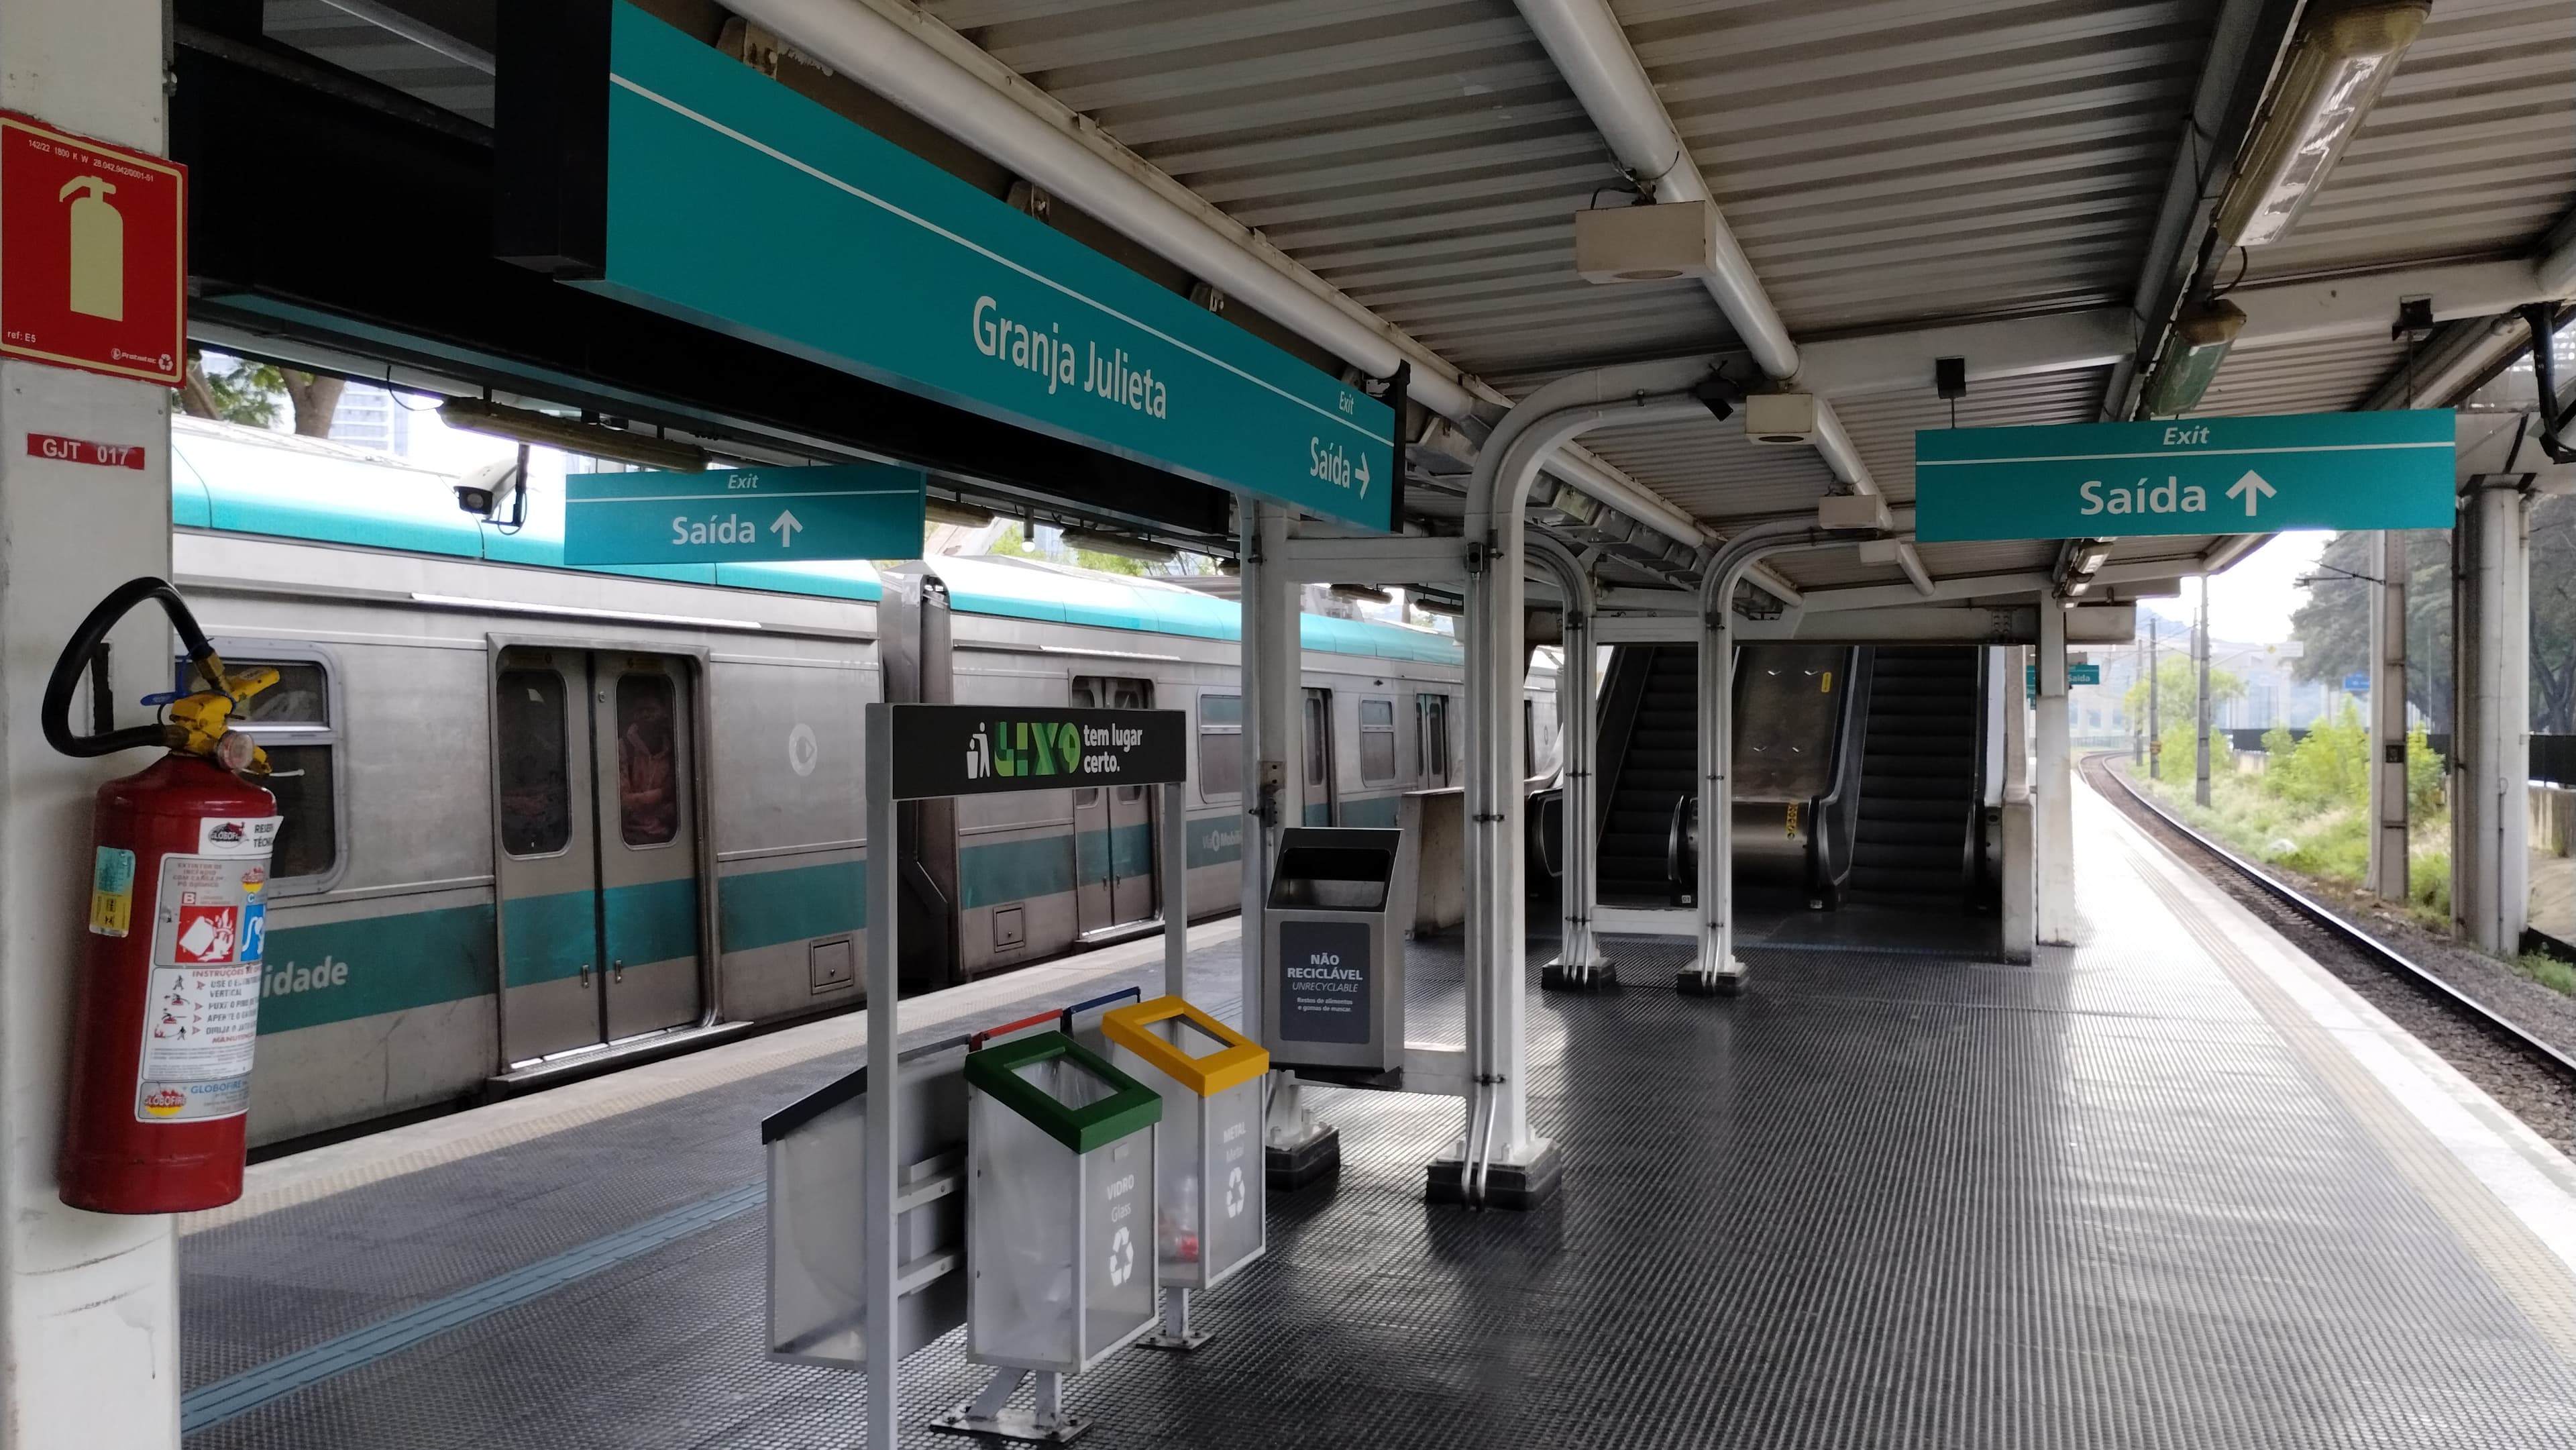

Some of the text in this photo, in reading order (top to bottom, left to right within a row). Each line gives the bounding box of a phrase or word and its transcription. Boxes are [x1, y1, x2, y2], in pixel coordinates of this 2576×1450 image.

[72, 152, 78, 160] K
[80, 155, 89, 164] W
[7, 331, 36, 343] ref: E5
[973, 295, 1167, 420] Granja Julieta
[1339, 391, 1354, 416] Exit
[2162, 426, 2210, 446] Exit
[42, 438, 129, 466] GJT 017
[1309, 435, 1350, 489] Saída
[727, 474, 759, 489] Exit
[2080, 475, 2206, 516] Saída
[672, 513, 755, 546] Saída
[994, 721, 1143, 777] LIXO tem lugar
[1083, 752, 1120, 774] certo.
[184, 892, 195, 904] B
[248, 893, 254, 902] C
[1310, 952, 1340, 966] NÃO
[1287, 967, 1363, 980] RECICLÁVEL
[1292, 982, 1358, 992] UNRECYCLABLE
[191, 1080, 242, 1094] GLOBOFIRE
[1223, 1121, 1247, 1143] METAL
[1107, 1174, 1134, 1200] VIDRO
[1111, 1202, 1131, 1223] Glass
